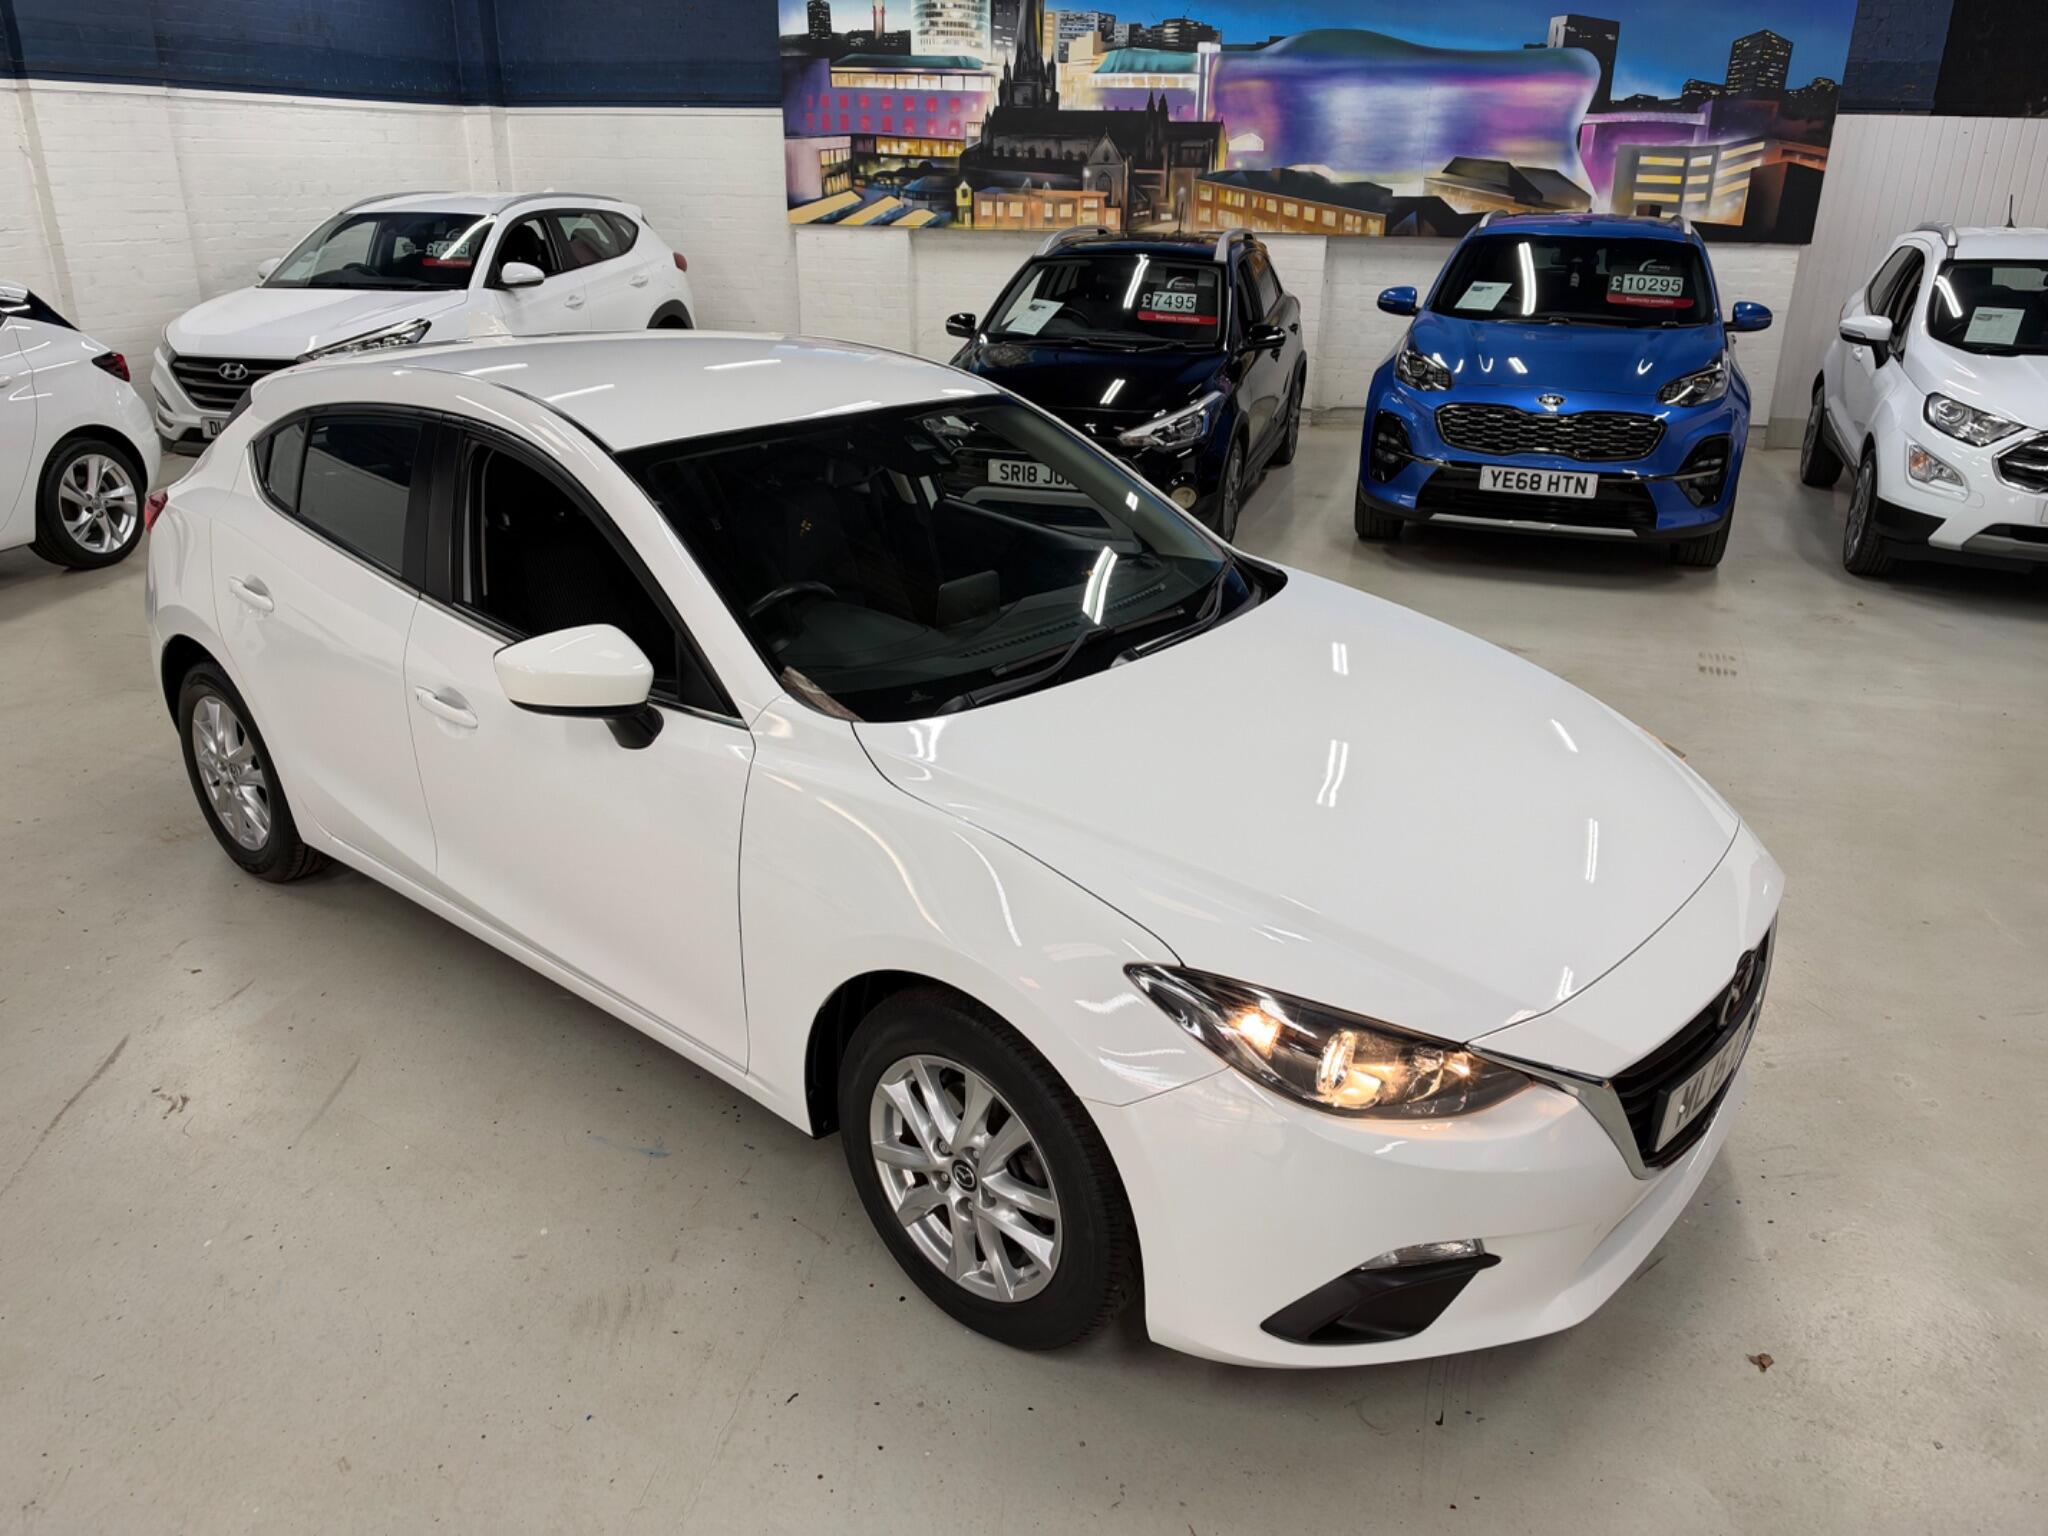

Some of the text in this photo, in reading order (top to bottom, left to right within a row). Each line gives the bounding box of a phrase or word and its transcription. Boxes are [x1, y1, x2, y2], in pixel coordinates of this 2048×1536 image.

[1610, 276, 1680, 293] £10295
[1141, 293, 1195, 309] £7495
[999, 463, 1038, 483] SR18
[1490, 469, 1589, 495] YE68 HTN
